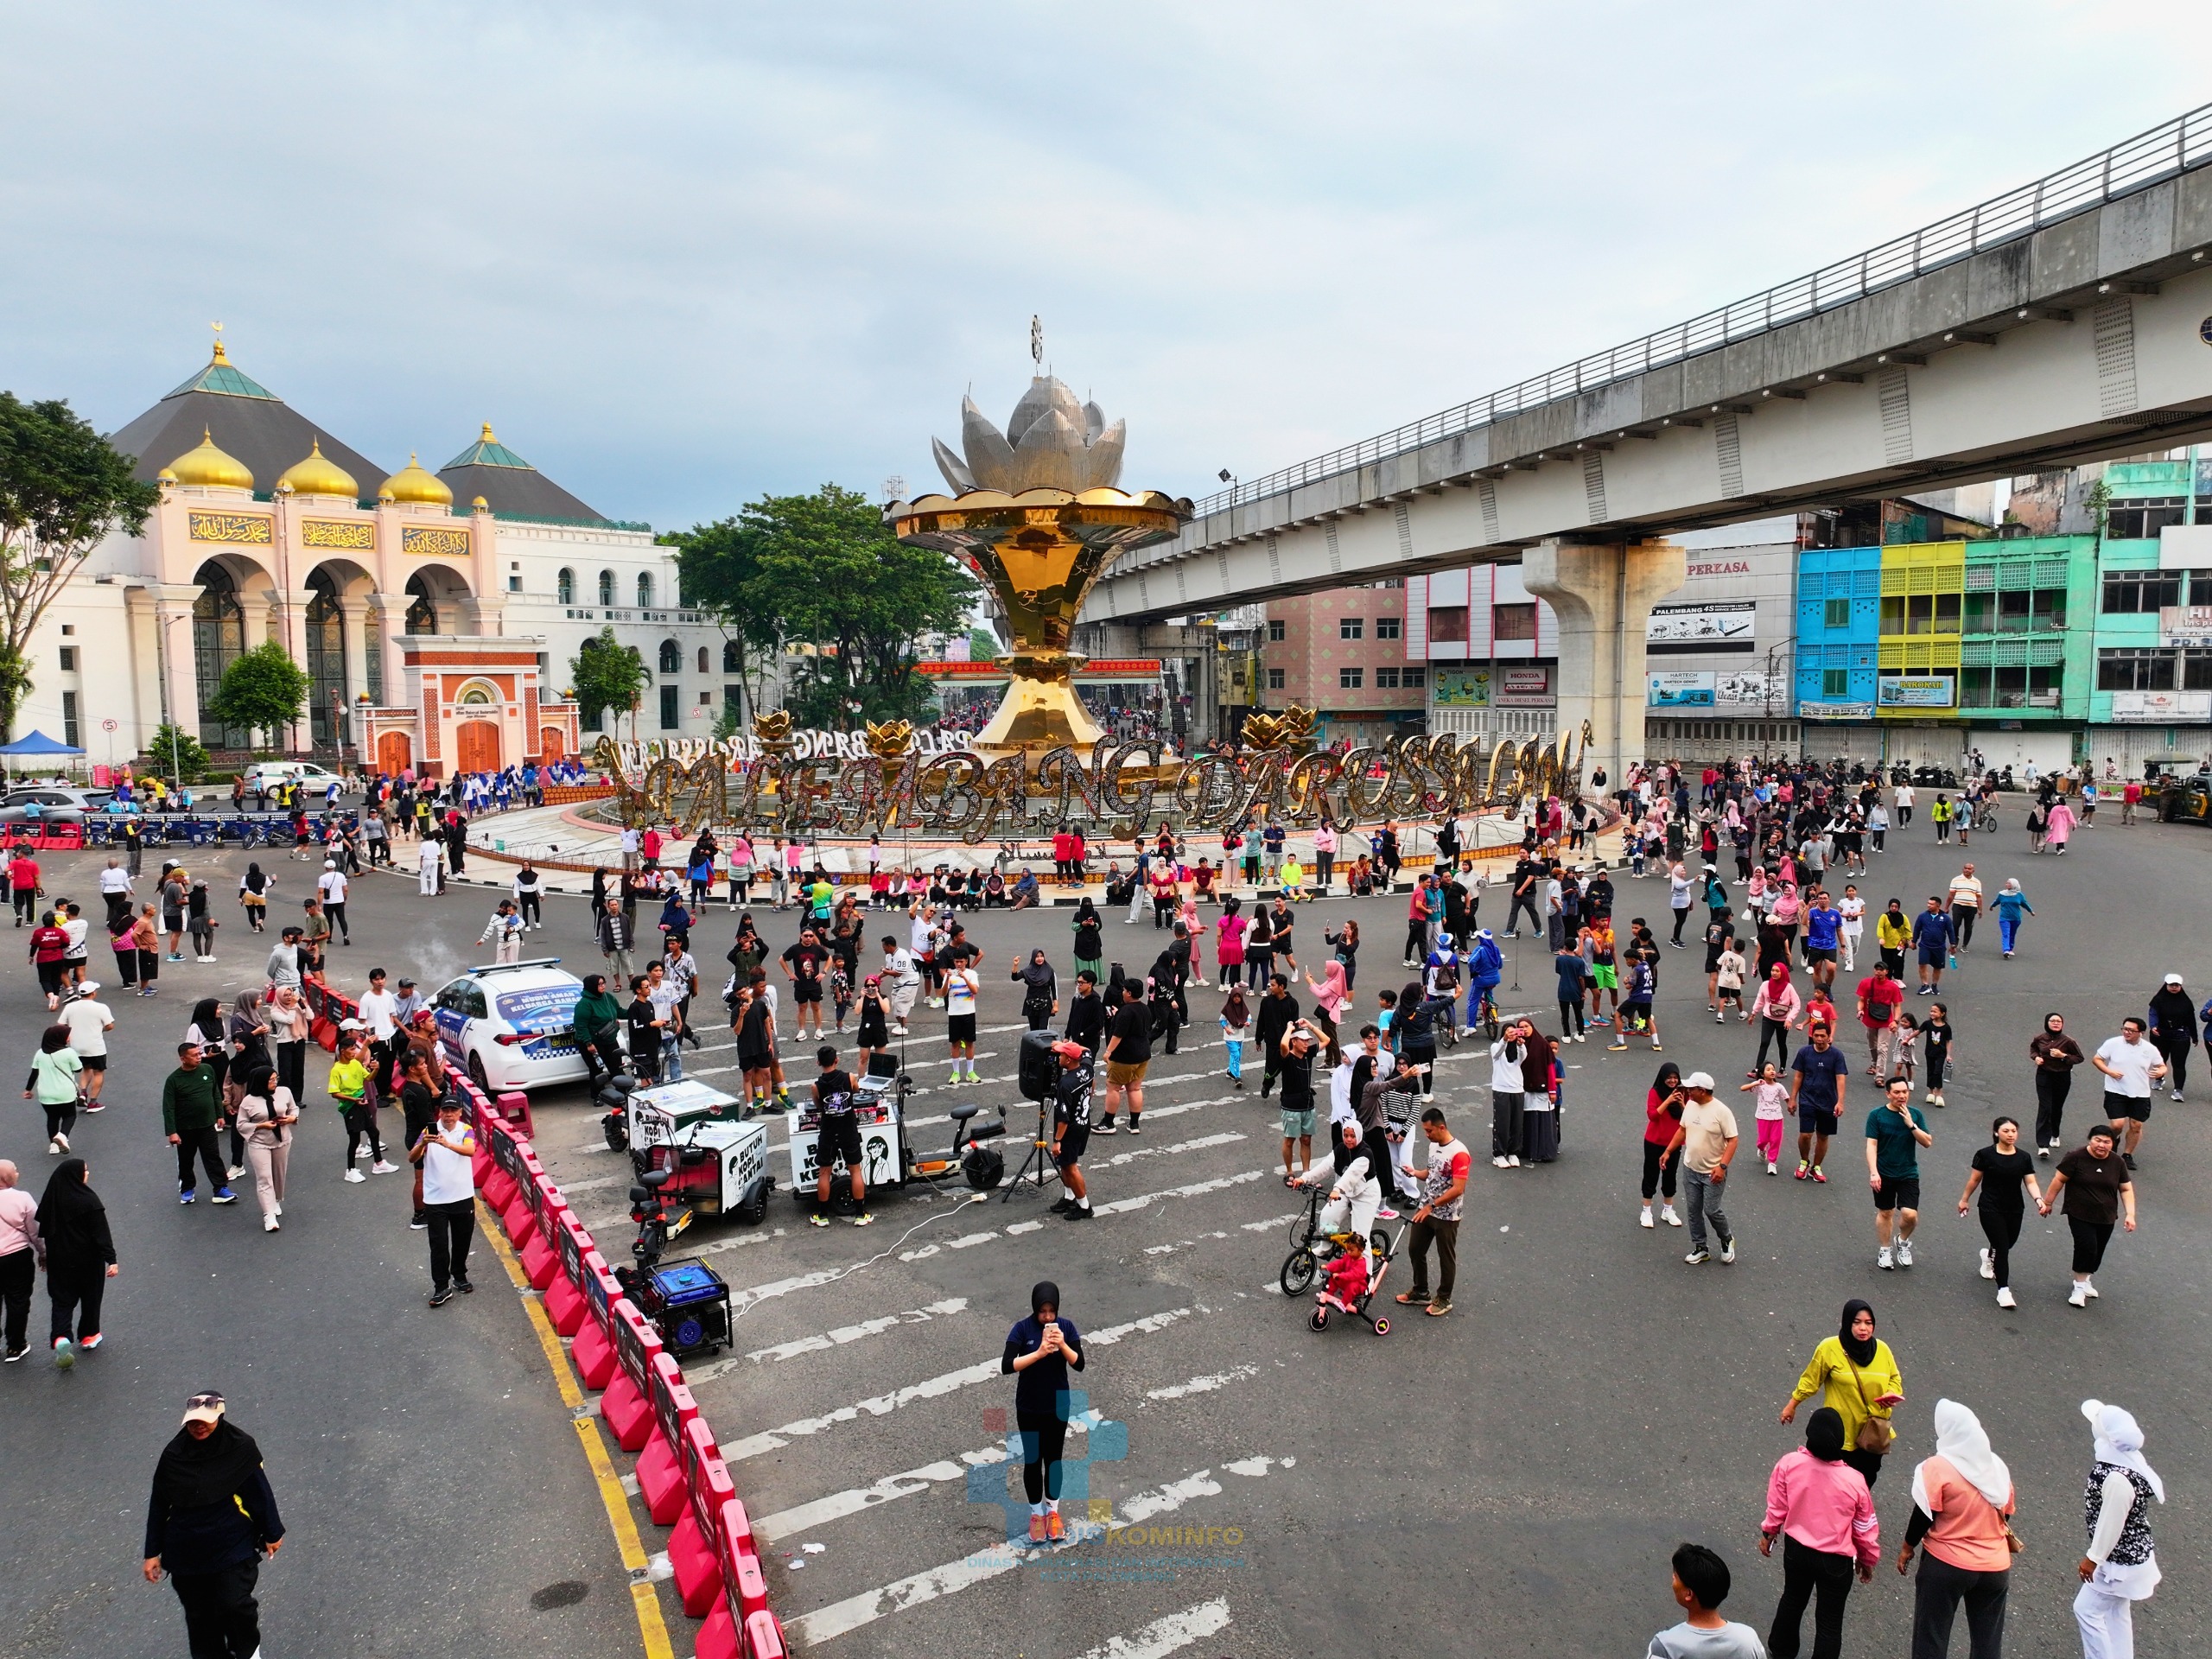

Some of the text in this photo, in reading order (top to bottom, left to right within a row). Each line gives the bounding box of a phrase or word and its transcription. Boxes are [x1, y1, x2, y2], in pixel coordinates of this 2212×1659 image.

[1687, 562, 1750, 575] PERKASA
[1899, 681, 1943, 690] BAROKAH
[643, 719, 1595, 845] PALEMBANG DARUSSALAM
[511, 1000, 554, 1012] KELUARGA
[440, 1025, 458, 1045] POLISI
[645, 1125, 661, 1138] KOPI
[740, 1133, 763, 1164] BUTUH
[738, 1154, 754, 1177] KOPI
